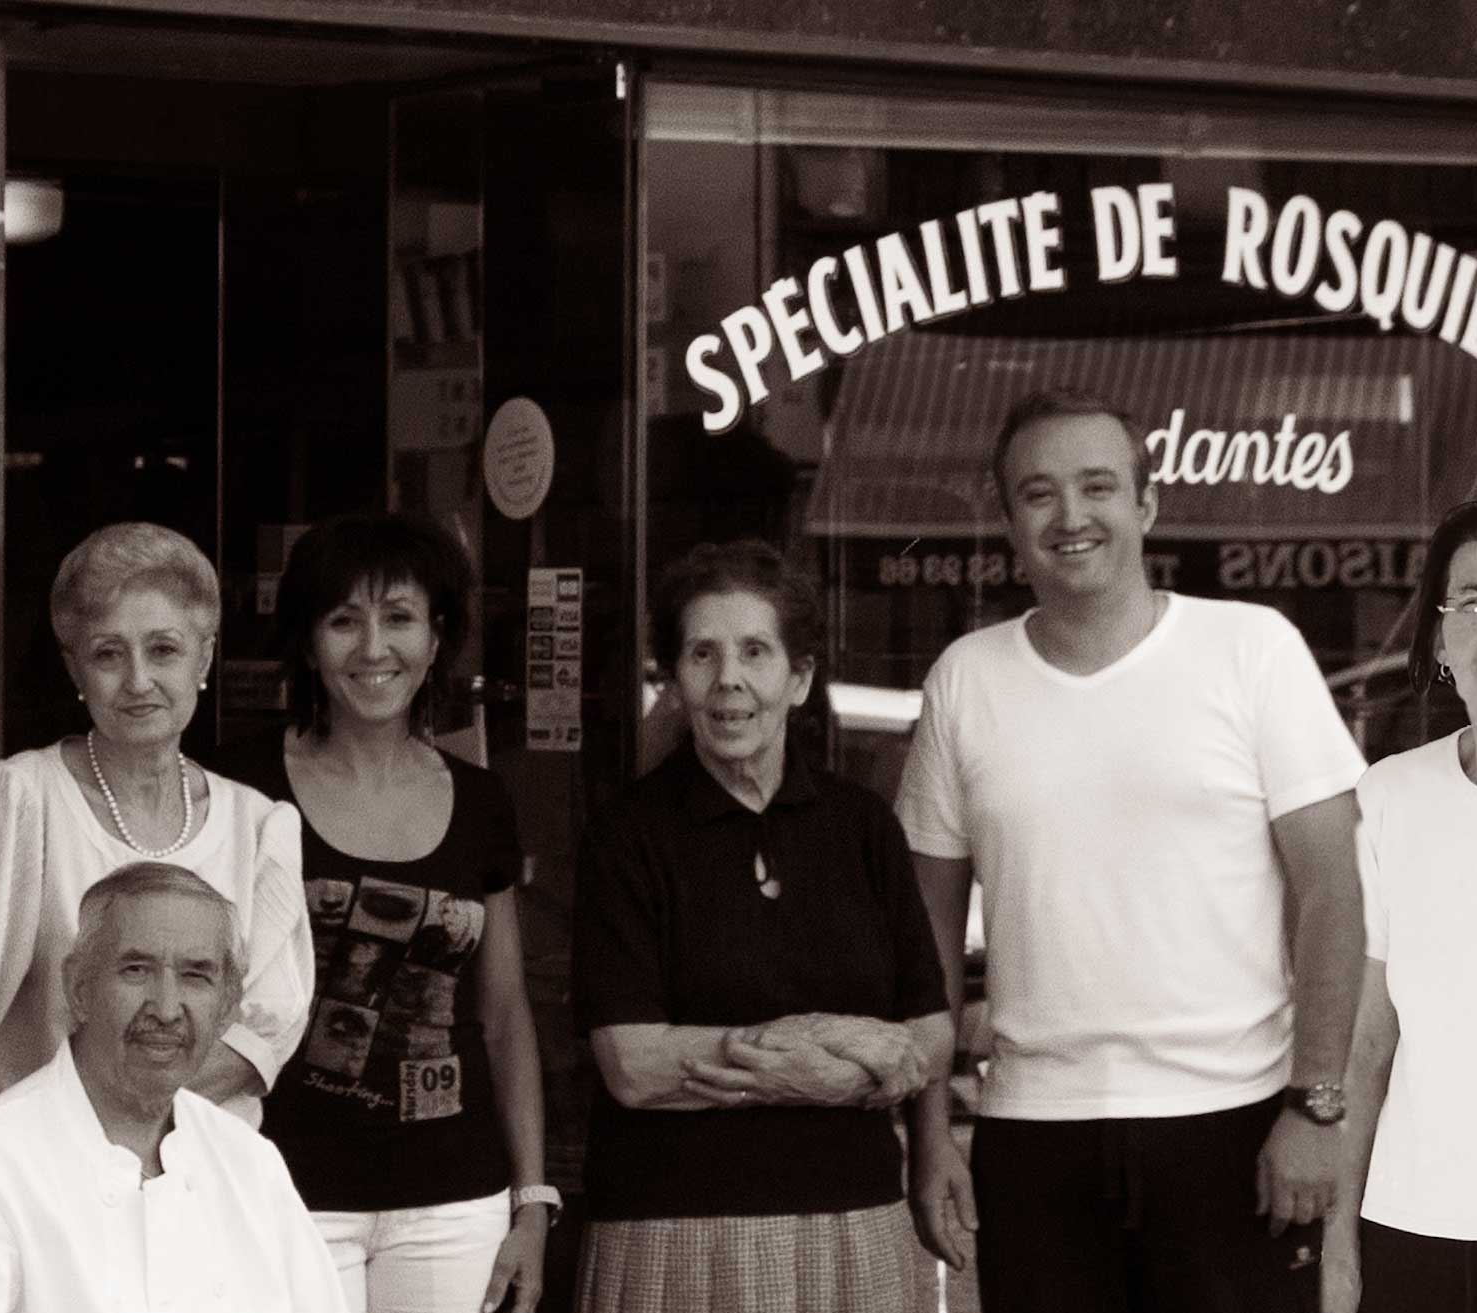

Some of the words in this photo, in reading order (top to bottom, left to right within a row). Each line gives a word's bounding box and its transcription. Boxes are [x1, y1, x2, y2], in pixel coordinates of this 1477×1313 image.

[1090, 182, 1179, 285] DE
[1145, 408, 1355, 495] dantes
[420, 1064, 456, 1093] 09
